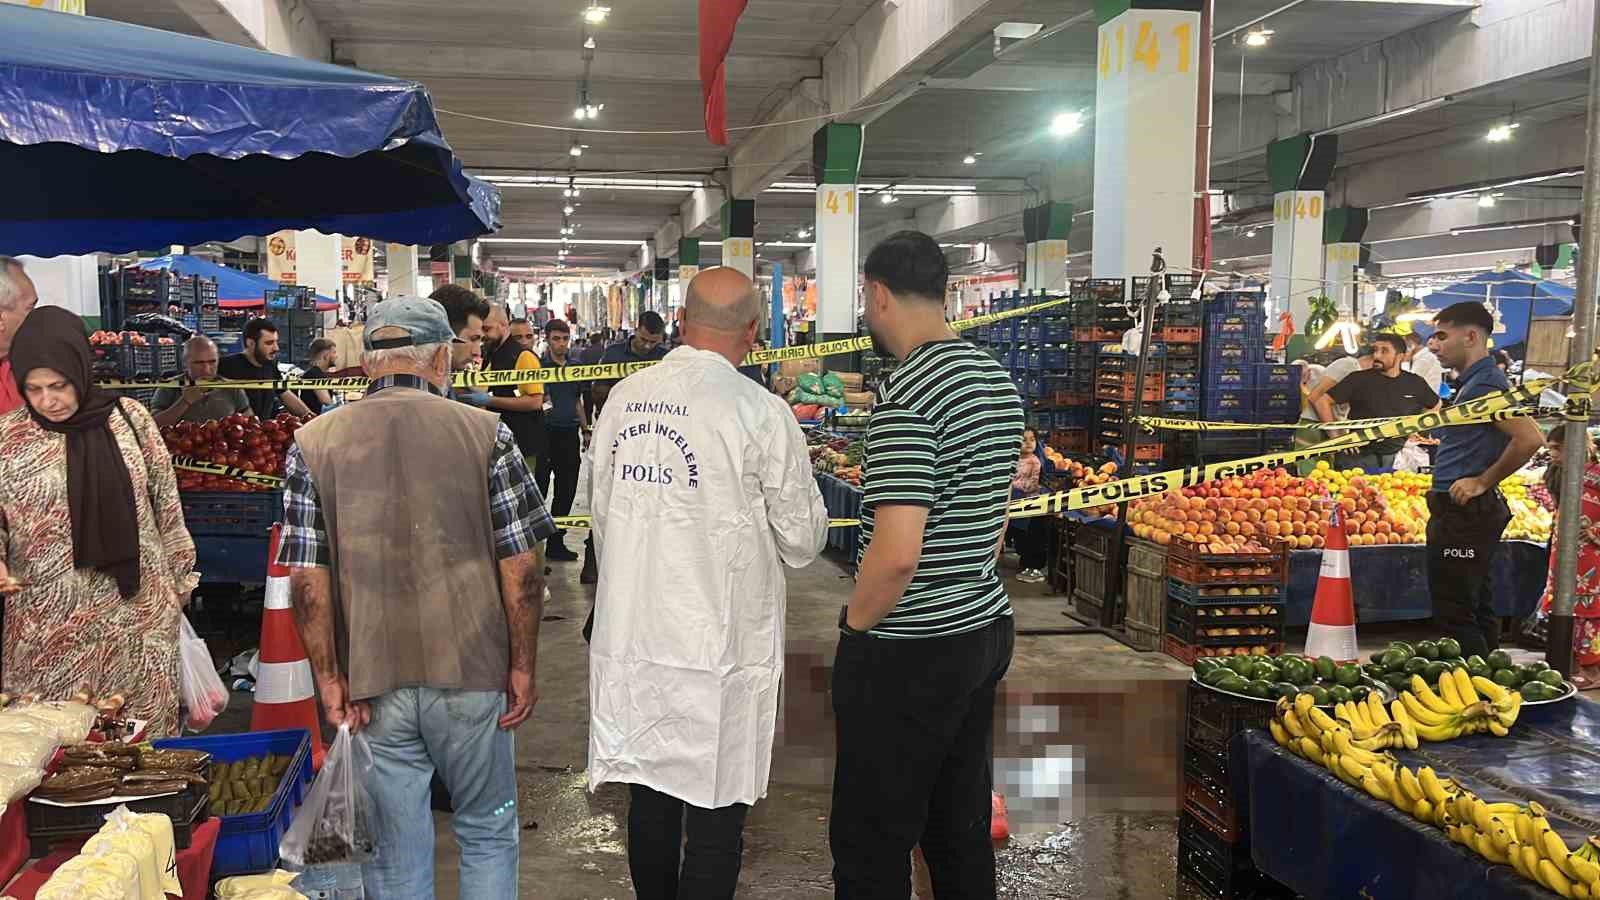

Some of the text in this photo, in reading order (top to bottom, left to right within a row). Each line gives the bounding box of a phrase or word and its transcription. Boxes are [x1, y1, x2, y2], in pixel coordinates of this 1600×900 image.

[1134, 20, 1190, 74] 41
[826, 190, 854, 215] 41
[1296, 195, 1321, 220] 40
[625, 401, 689, 417] KRİMİNAL
[619, 420, 652, 441] YERİ
[655, 421, 698, 488] İNCELEME
[621, 464, 673, 485] POLİS
[165, 848, 177, 878] 4
